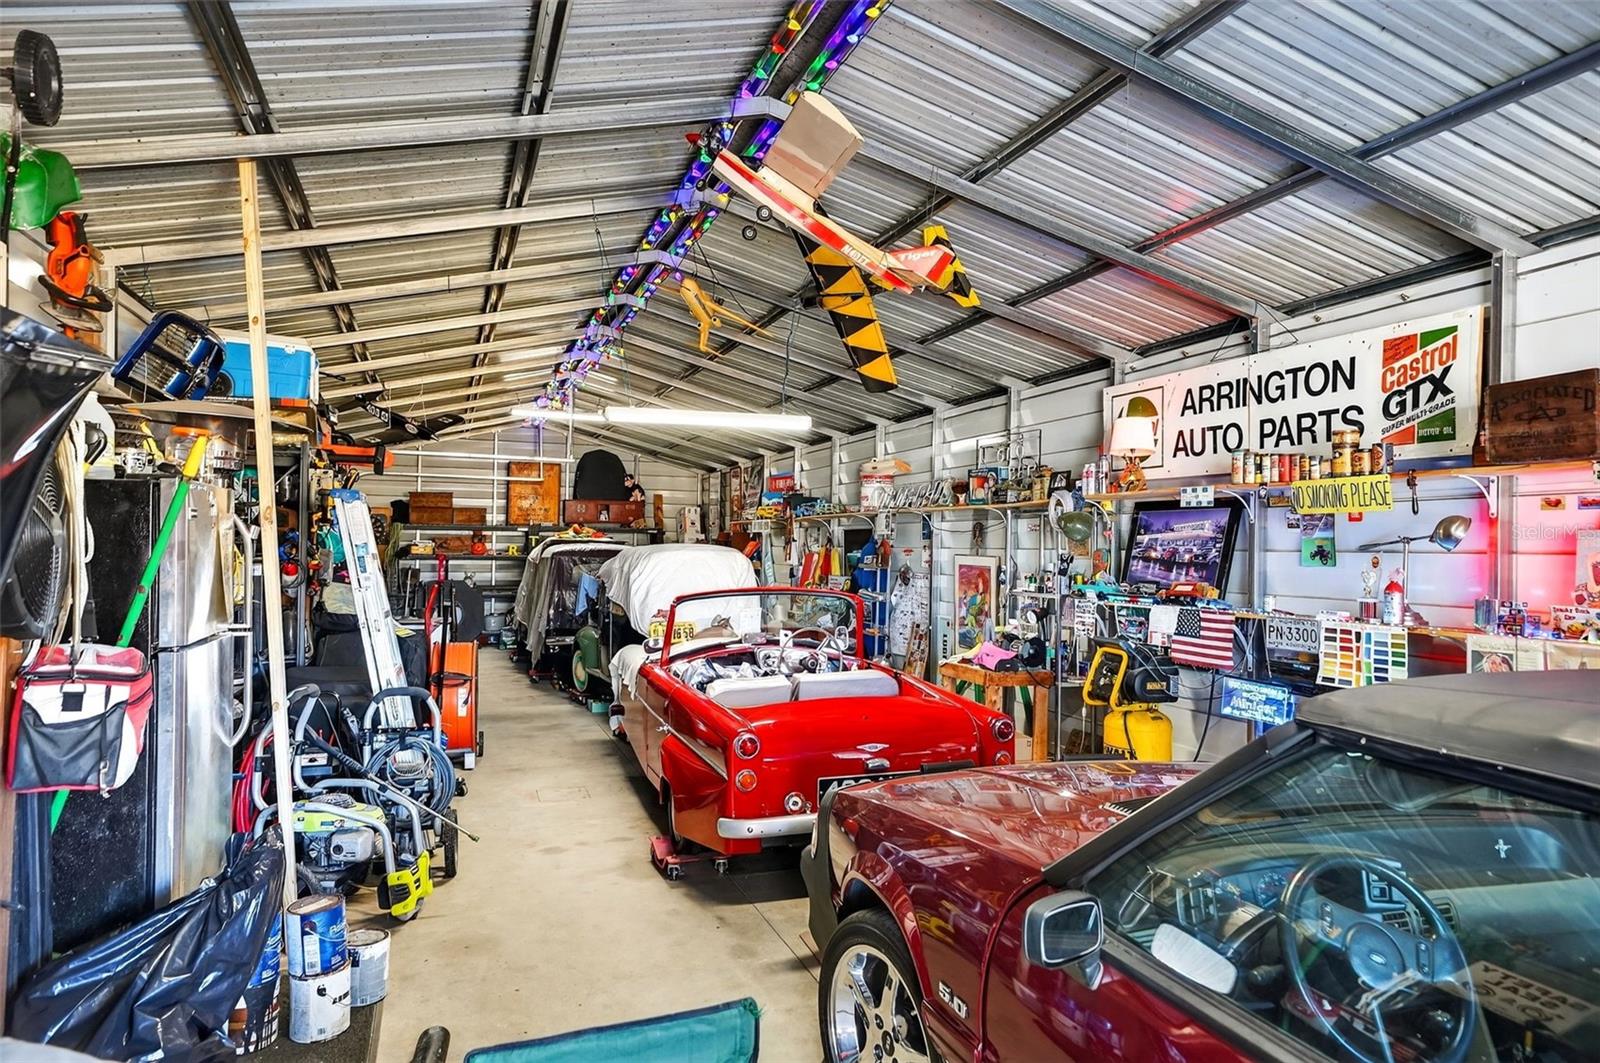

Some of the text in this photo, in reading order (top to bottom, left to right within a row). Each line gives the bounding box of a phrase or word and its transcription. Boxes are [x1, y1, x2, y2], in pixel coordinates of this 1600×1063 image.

[1181, 356, 1356, 417] ARRINGTON
[1381, 333, 1458, 394] Castrol
[1382, 363, 1454, 421] GTX
[1172, 405, 1364, 458] AUTO PARTS
[1381, 419, 1405, 435] SUPER
[1306, 482, 1348, 509] SMOKING
[1351, 480, 1391, 508] PLEASE
[939, 981, 968, 1019] 5.0
